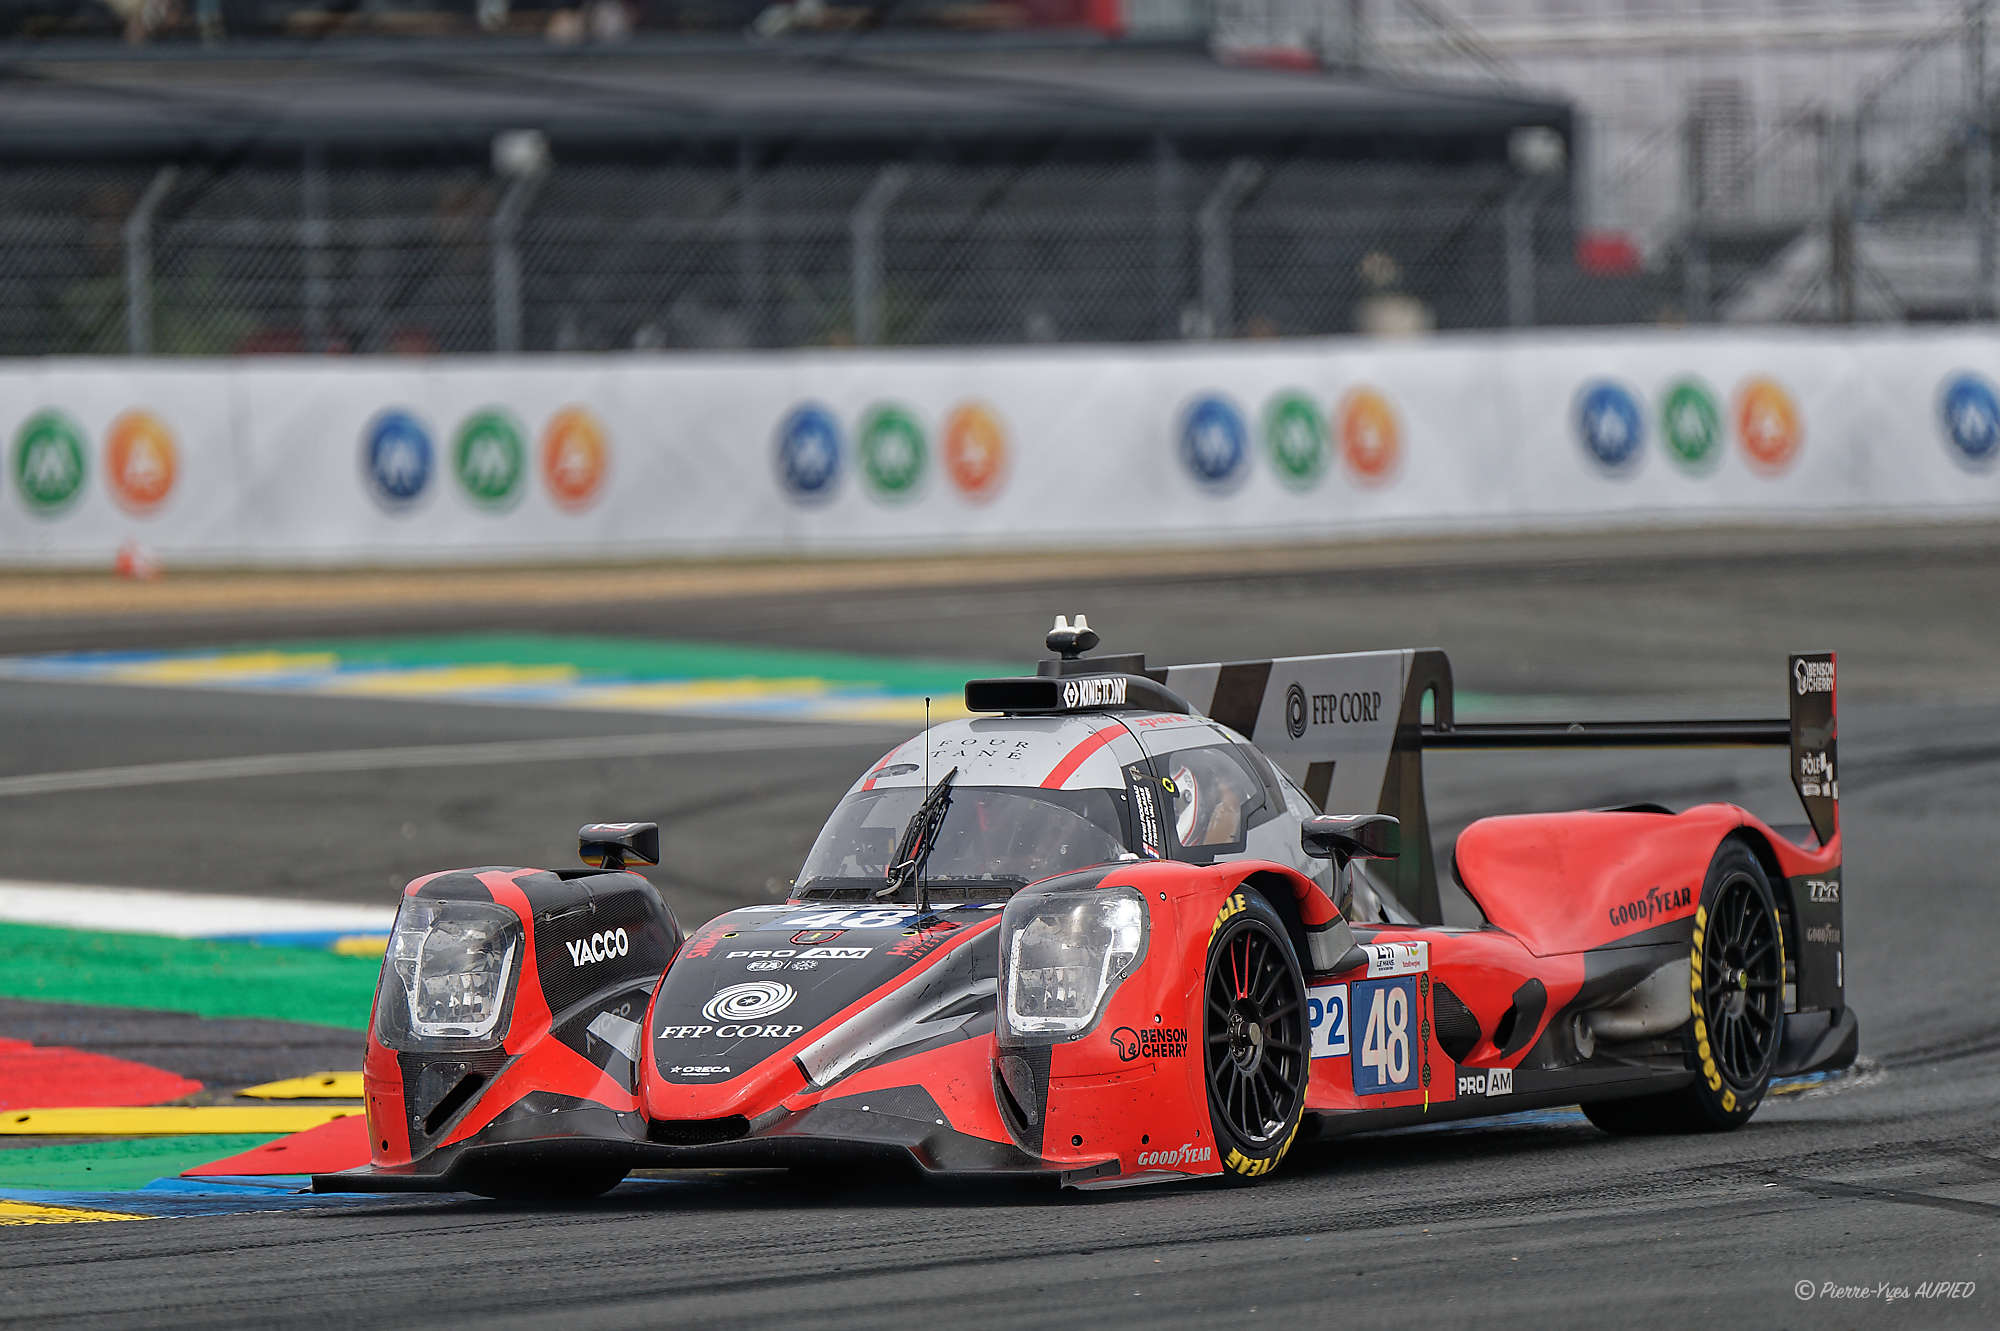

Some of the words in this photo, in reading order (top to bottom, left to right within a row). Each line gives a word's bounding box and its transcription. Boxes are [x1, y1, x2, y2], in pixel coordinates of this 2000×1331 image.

[1808, 662, 1834, 677] BENSON
[1808, 677, 1834, 692] CHERRY
[1312, 694, 1337, 725] FFP
[1340, 691, 1382, 724] CORP
[938, 738, 1029, 749] FOUR
[1608, 886, 1692, 927] GOODYEAR
[781, 909, 918, 928] 48
[565, 927, 629, 967] YACCO
[725, 949, 797, 959] PRO
[805, 948, 869, 958] AM
[657, 1025, 713, 1039] FFP
[715, 1025, 804, 1038] CORP
[1140, 1027, 1188, 1043] BENSON
[1361, 986, 1411, 1085] 48
[1141, 1043, 1188, 1058] CHERRY
[1457, 1074, 1486, 1096] PRO
[1491, 1072, 1511, 1092] AM
[1137, 1143, 1212, 1168] GOODYEAR
